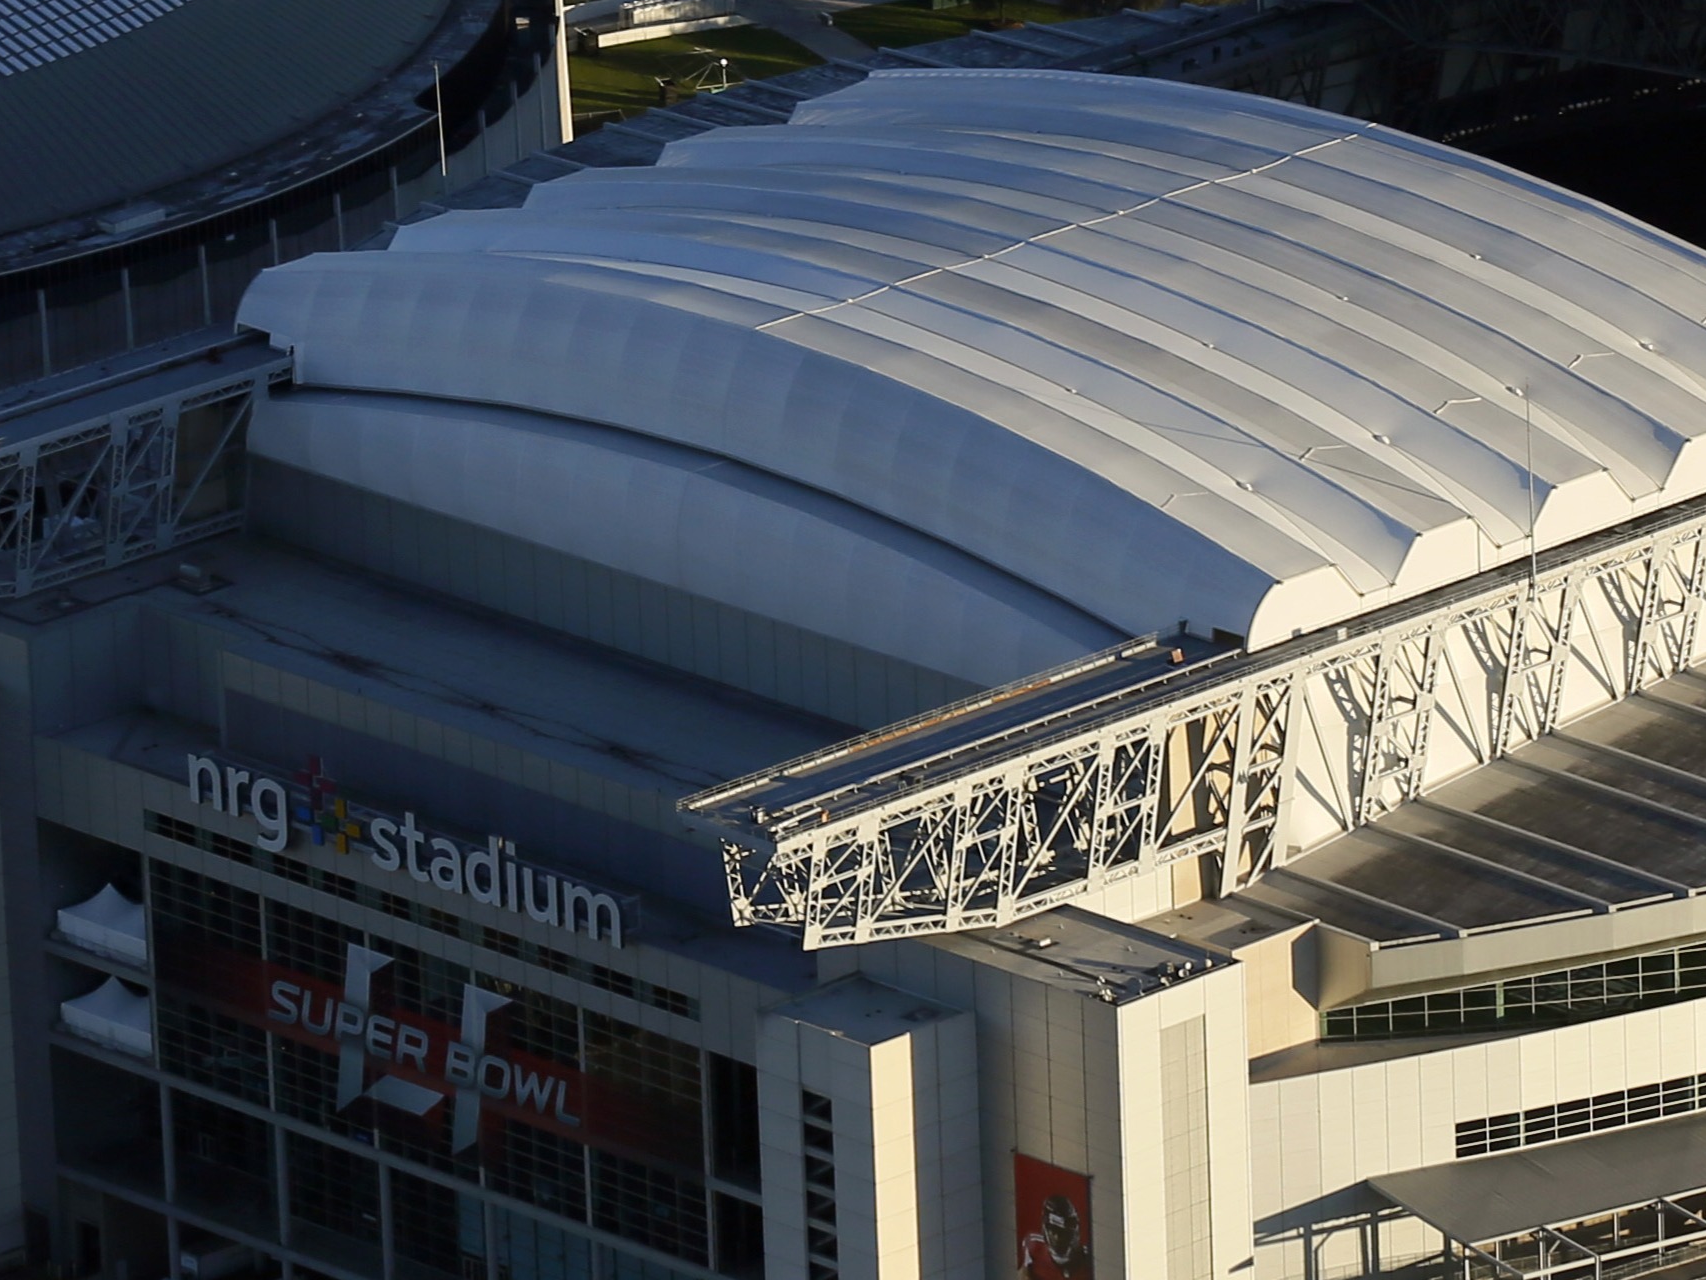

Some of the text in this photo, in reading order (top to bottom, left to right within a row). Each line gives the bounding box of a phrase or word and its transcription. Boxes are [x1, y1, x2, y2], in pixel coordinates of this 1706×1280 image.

[186, 752, 626, 950] nrg stadium
[267, 979, 583, 1127] SUPER BOWL
